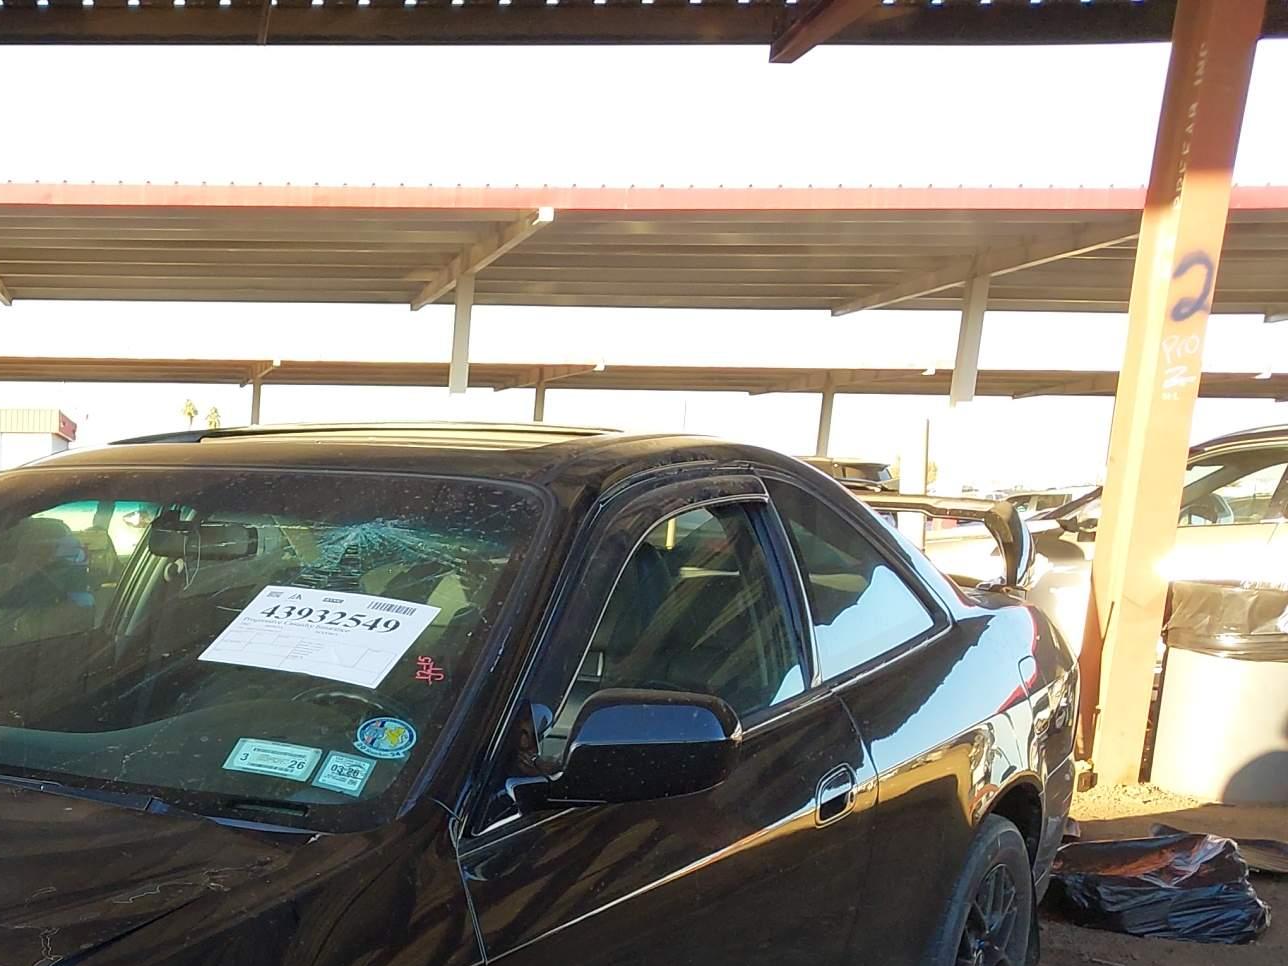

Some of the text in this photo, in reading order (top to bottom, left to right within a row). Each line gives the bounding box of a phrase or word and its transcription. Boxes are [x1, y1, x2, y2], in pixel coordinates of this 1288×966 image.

[1171, 250, 1213, 323] 2
[260, 603, 401, 634] 43932549
[240, 753, 249, 761] 3
[288, 759, 306, 770] 26
